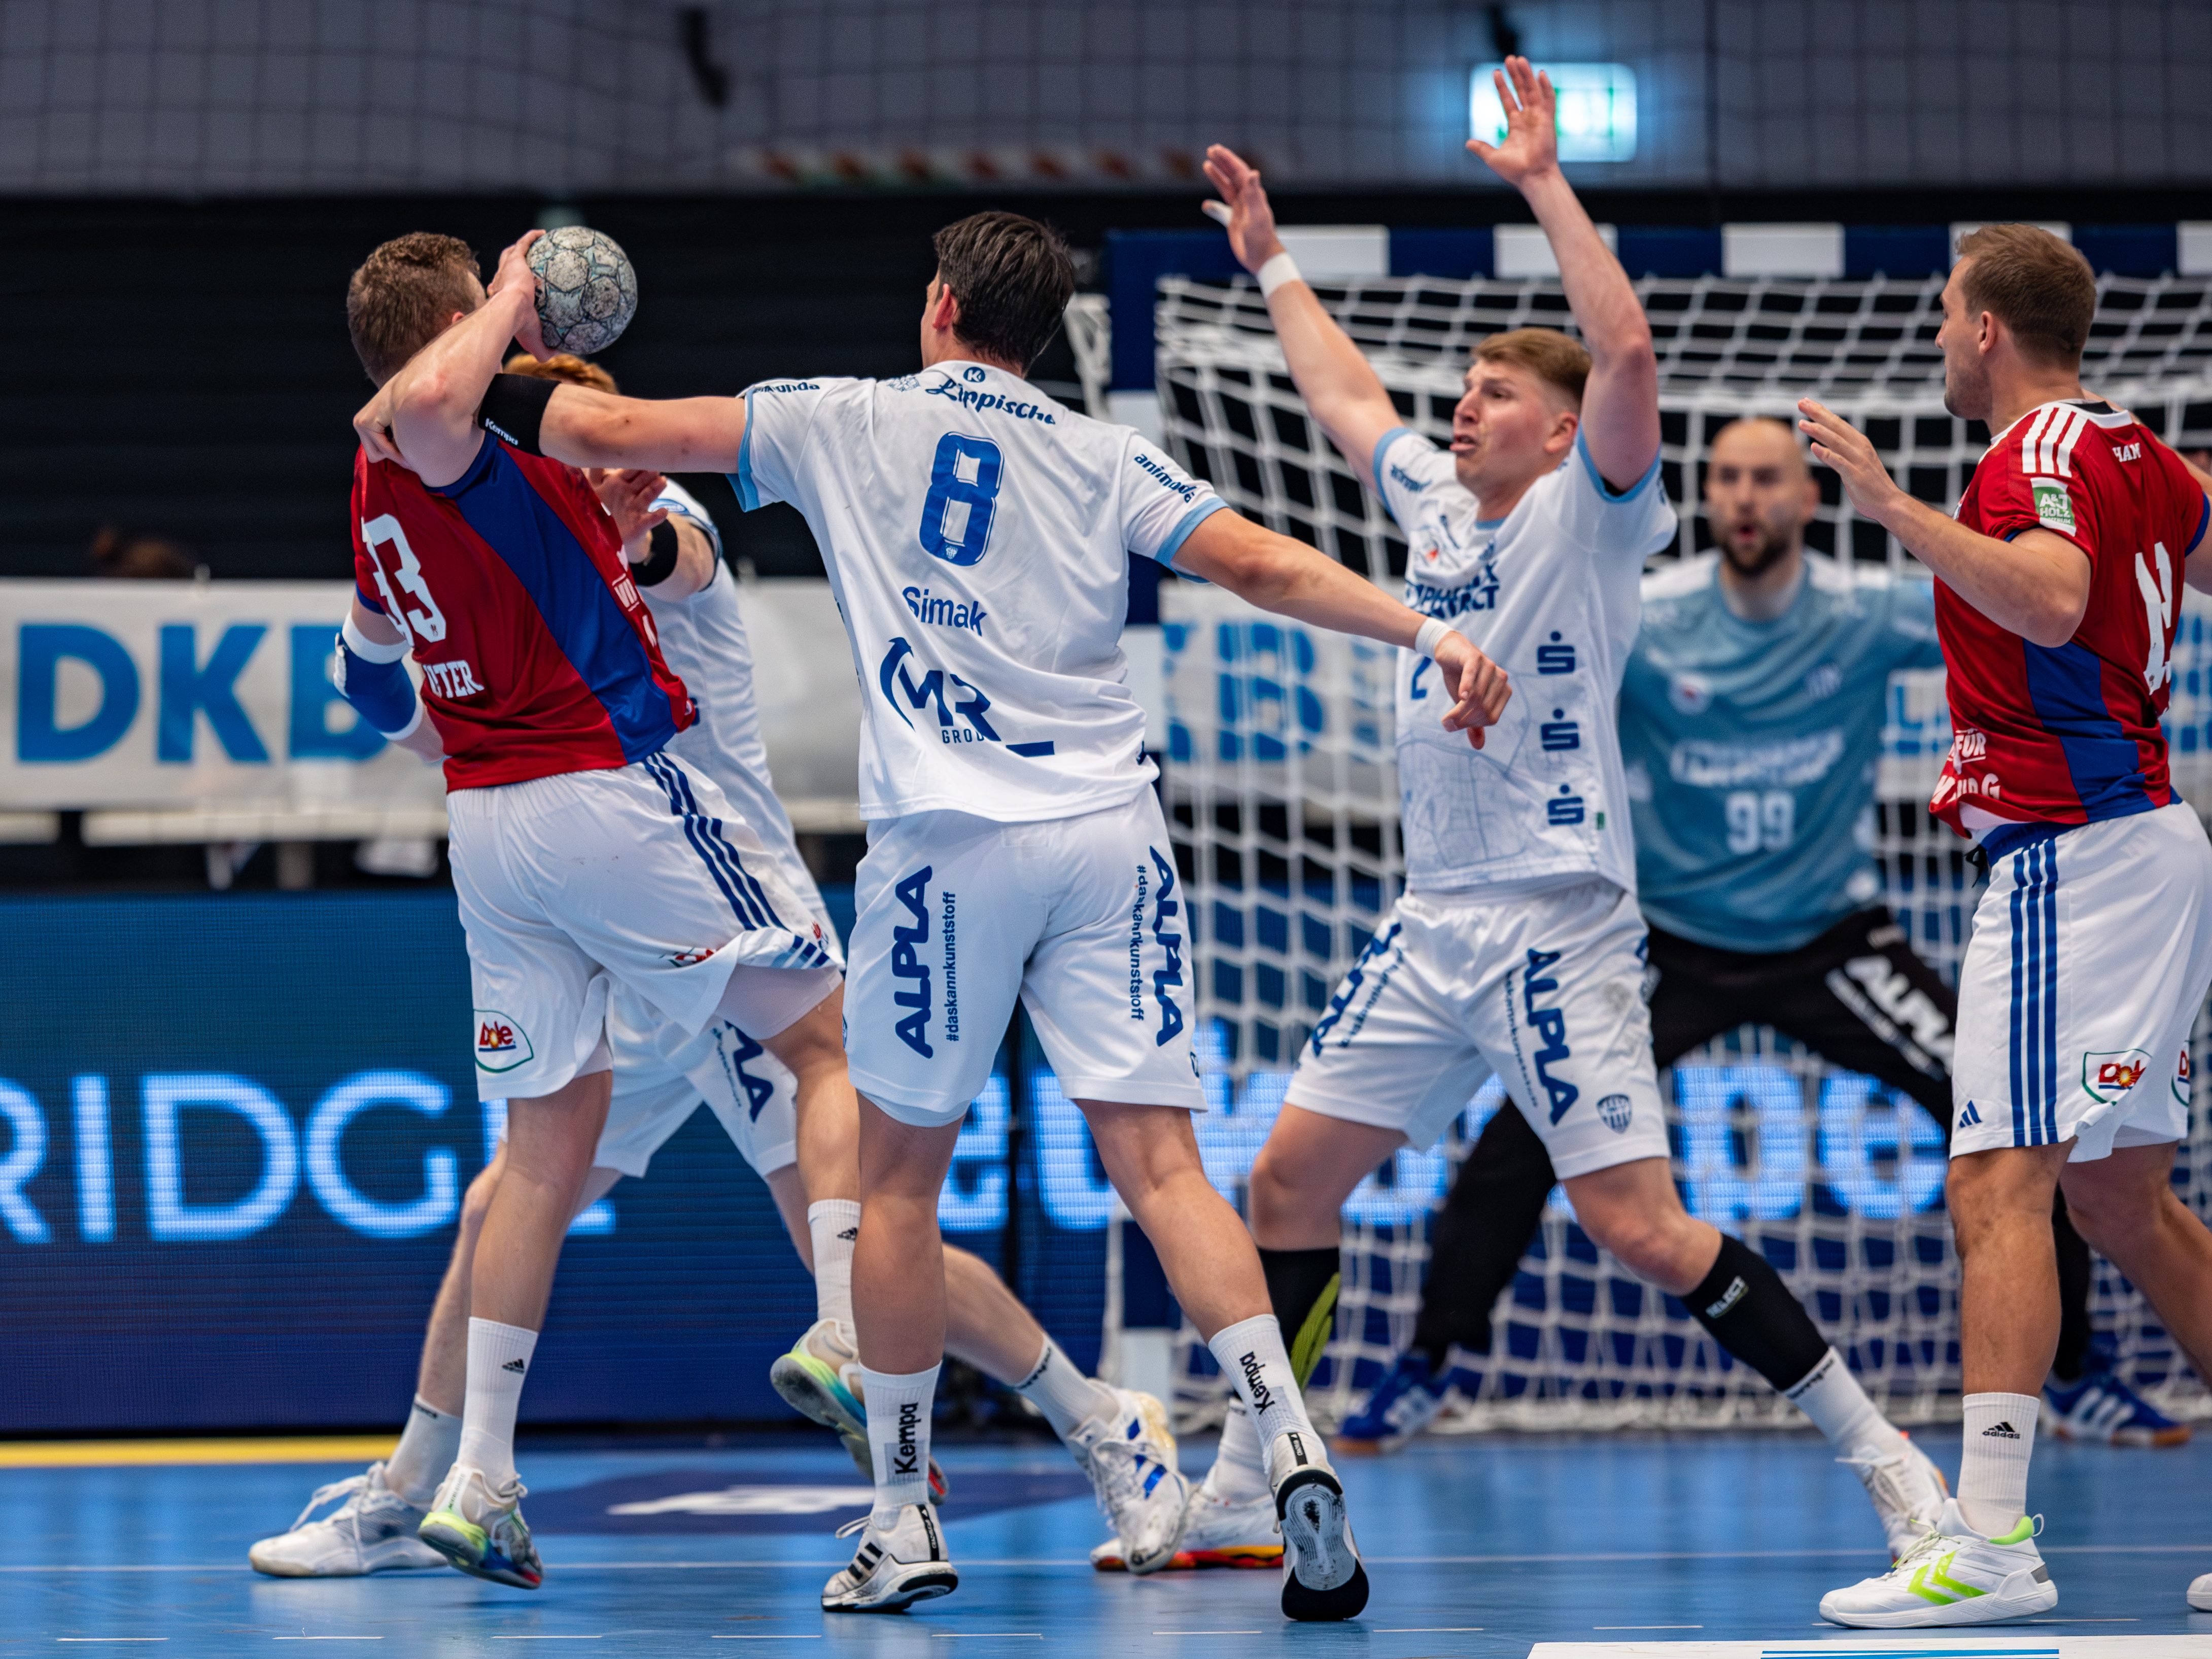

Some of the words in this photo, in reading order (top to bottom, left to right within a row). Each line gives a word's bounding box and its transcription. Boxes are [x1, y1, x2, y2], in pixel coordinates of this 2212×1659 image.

[485, 418, 518, 445] Kempa
[919, 431, 1005, 567] 8
[2040, 507, 2070, 517] HOLZ
[903, 586, 987, 637] Simak
[1726, 790, 1795, 853] 99
[892, 866, 933, 1059] ALPLA
[943, 891, 959, 1042] #daskannkunststoff
[1150, 845, 1183, 1047] ALPLA
[479, 1021, 513, 1049] Dole
[1524, 948, 1579, 1127] ALPLA
[2098, 1059, 2147, 1088] Dol
[1239, 1351, 1275, 1415] Kempa
[893, 1402, 920, 1474] Kempa
[1982, 1430, 2020, 1439] adidas
